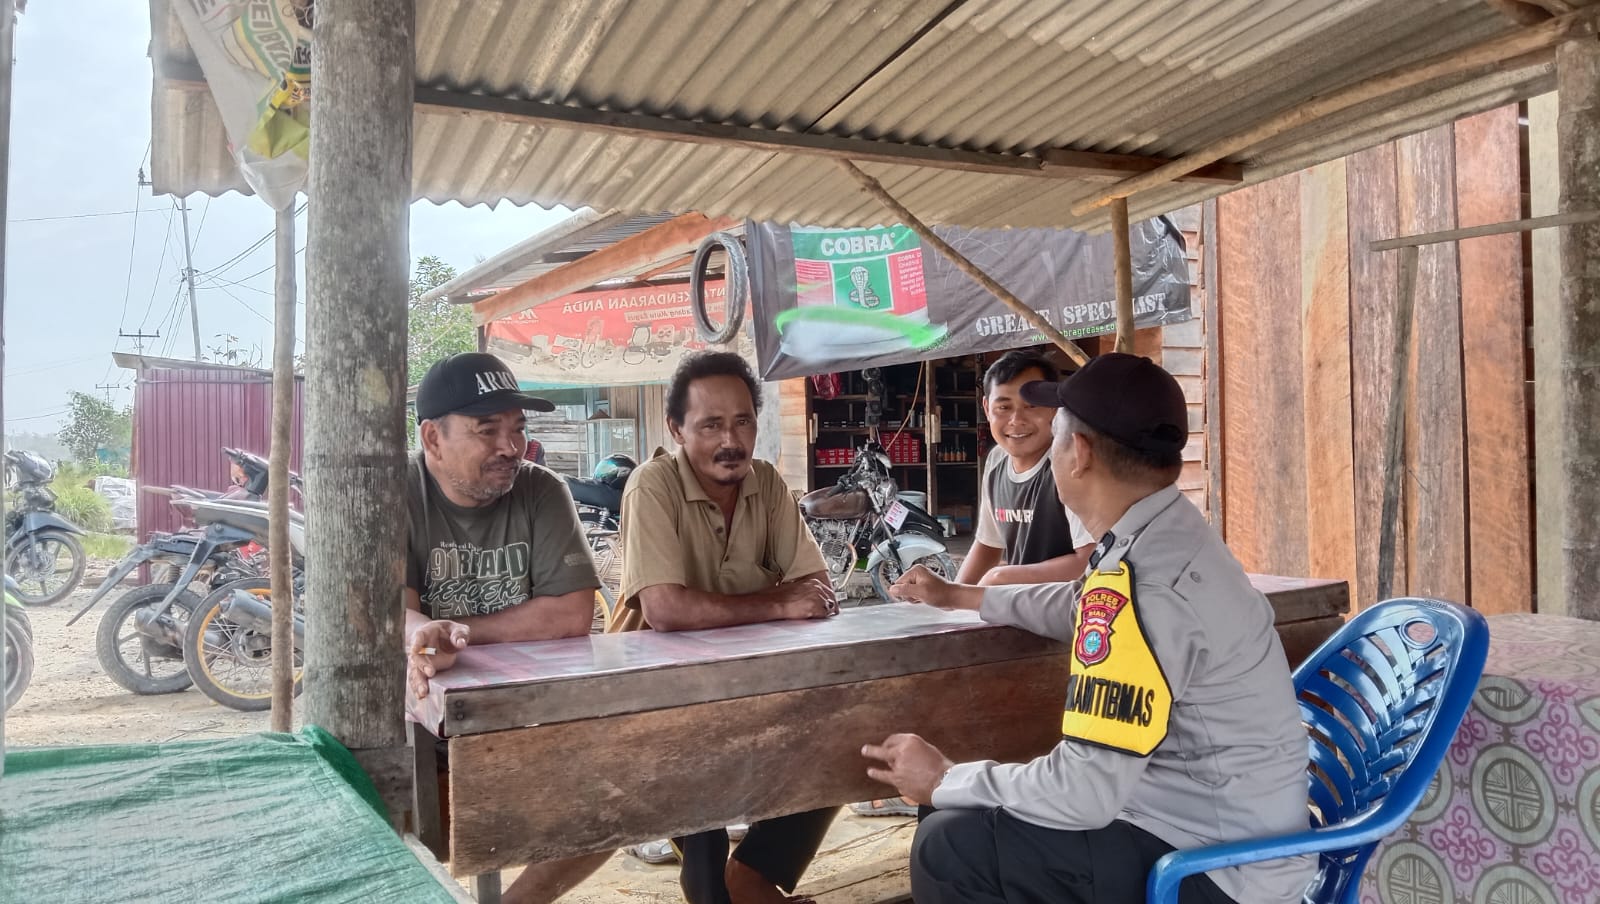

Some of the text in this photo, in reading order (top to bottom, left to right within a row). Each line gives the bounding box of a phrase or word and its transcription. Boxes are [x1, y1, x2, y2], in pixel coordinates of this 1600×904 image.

[820, 233, 894, 256] COBRA
[975, 293, 1167, 337] GREAE SPECILIST
[1086, 593, 1119, 606] POLRES
